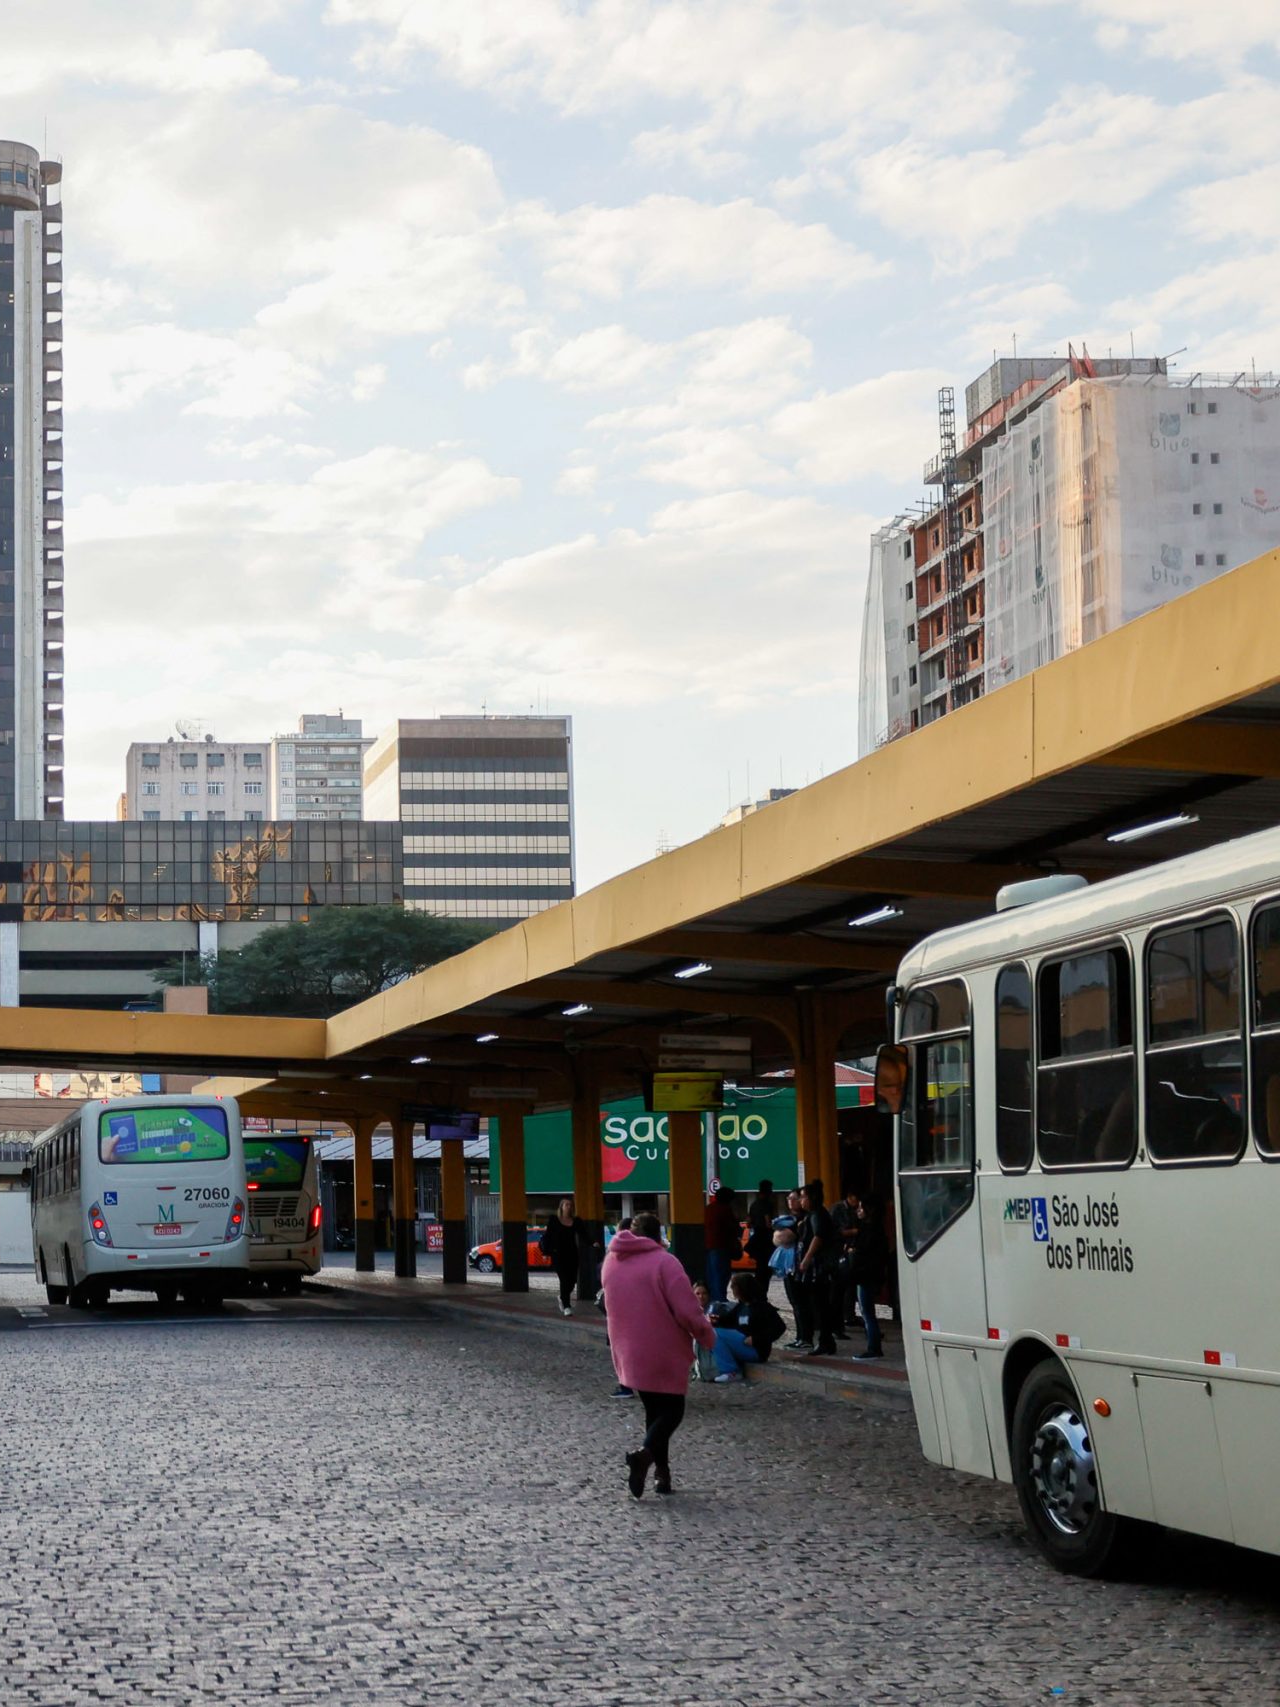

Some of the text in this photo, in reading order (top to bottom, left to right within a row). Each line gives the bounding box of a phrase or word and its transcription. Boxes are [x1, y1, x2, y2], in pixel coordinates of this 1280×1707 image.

[184, 1187, 230, 1201] 27060
[158, 1204, 175, 1222] M
[1052, 1192, 1119, 1227] São José
[273, 1217, 305, 1229] 19404
[1046, 1237, 1134, 1273] dos Pinhais
